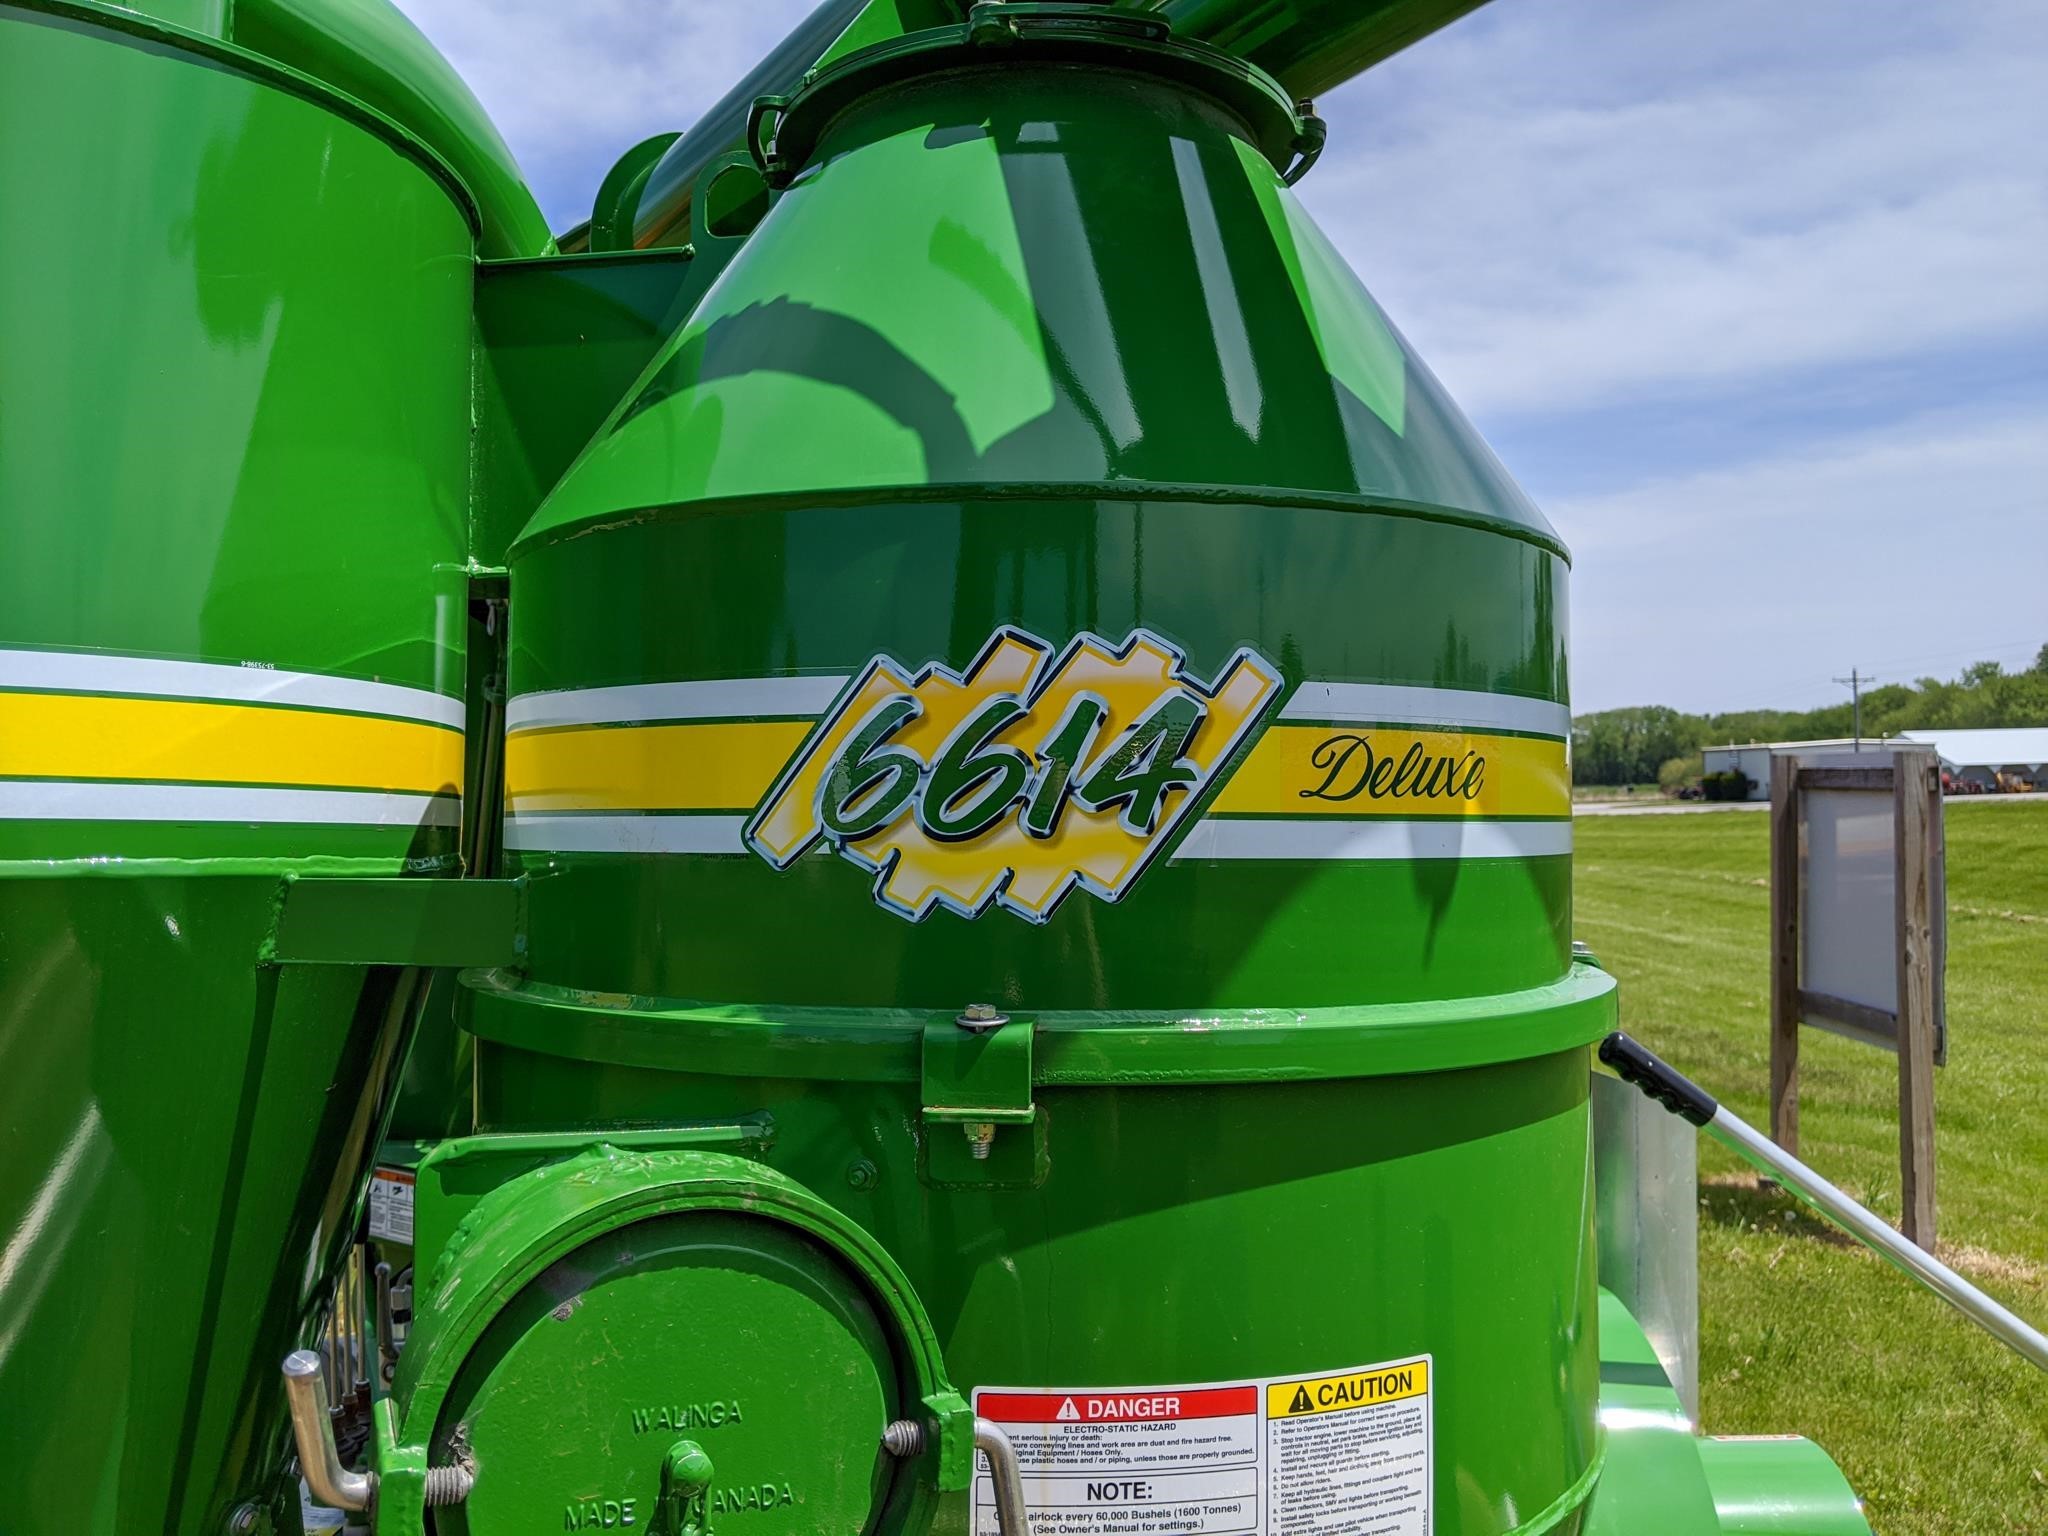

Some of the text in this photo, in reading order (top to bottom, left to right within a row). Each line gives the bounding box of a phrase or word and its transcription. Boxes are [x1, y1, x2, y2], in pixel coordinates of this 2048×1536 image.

[817, 692, 1203, 841] 6614
[1299, 735, 1485, 801] Deluxe
[1317, 1370, 1412, 1405] CAUTION
[632, 1400, 743, 1434] WALINGA
[1088, 1397, 1180, 1418] DANGER
[1064, 1423, 1176, 1434] ELECTRO-STATIC HAZARD
[1030, 1442, 1066, 1450] conveying
[1167, 1438, 1180, 1446] and
[1194, 1436, 1216, 1444] hazard
[1050, 1434, 1069, 1443] injury
[1032, 1457, 1055, 1465] plastic
[1108, 1456, 1132, 1465] piping,
[1192, 1451, 1220, 1460] properly
[1221, 1448, 1255, 1458] grounded.
[1037, 1450, 1075, 1458] Equipment
[1104, 1448, 1123, 1457] Only.
[1087, 1482, 1152, 1500] NOTE:
[565, 1498, 637, 1532] MADE
[1028, 1504, 1241, 1524] airlock every 60,000 Bushels (1600 Tonnes)
[1033, 1519, 1204, 1536] (See Owner's Manual for settings.)
